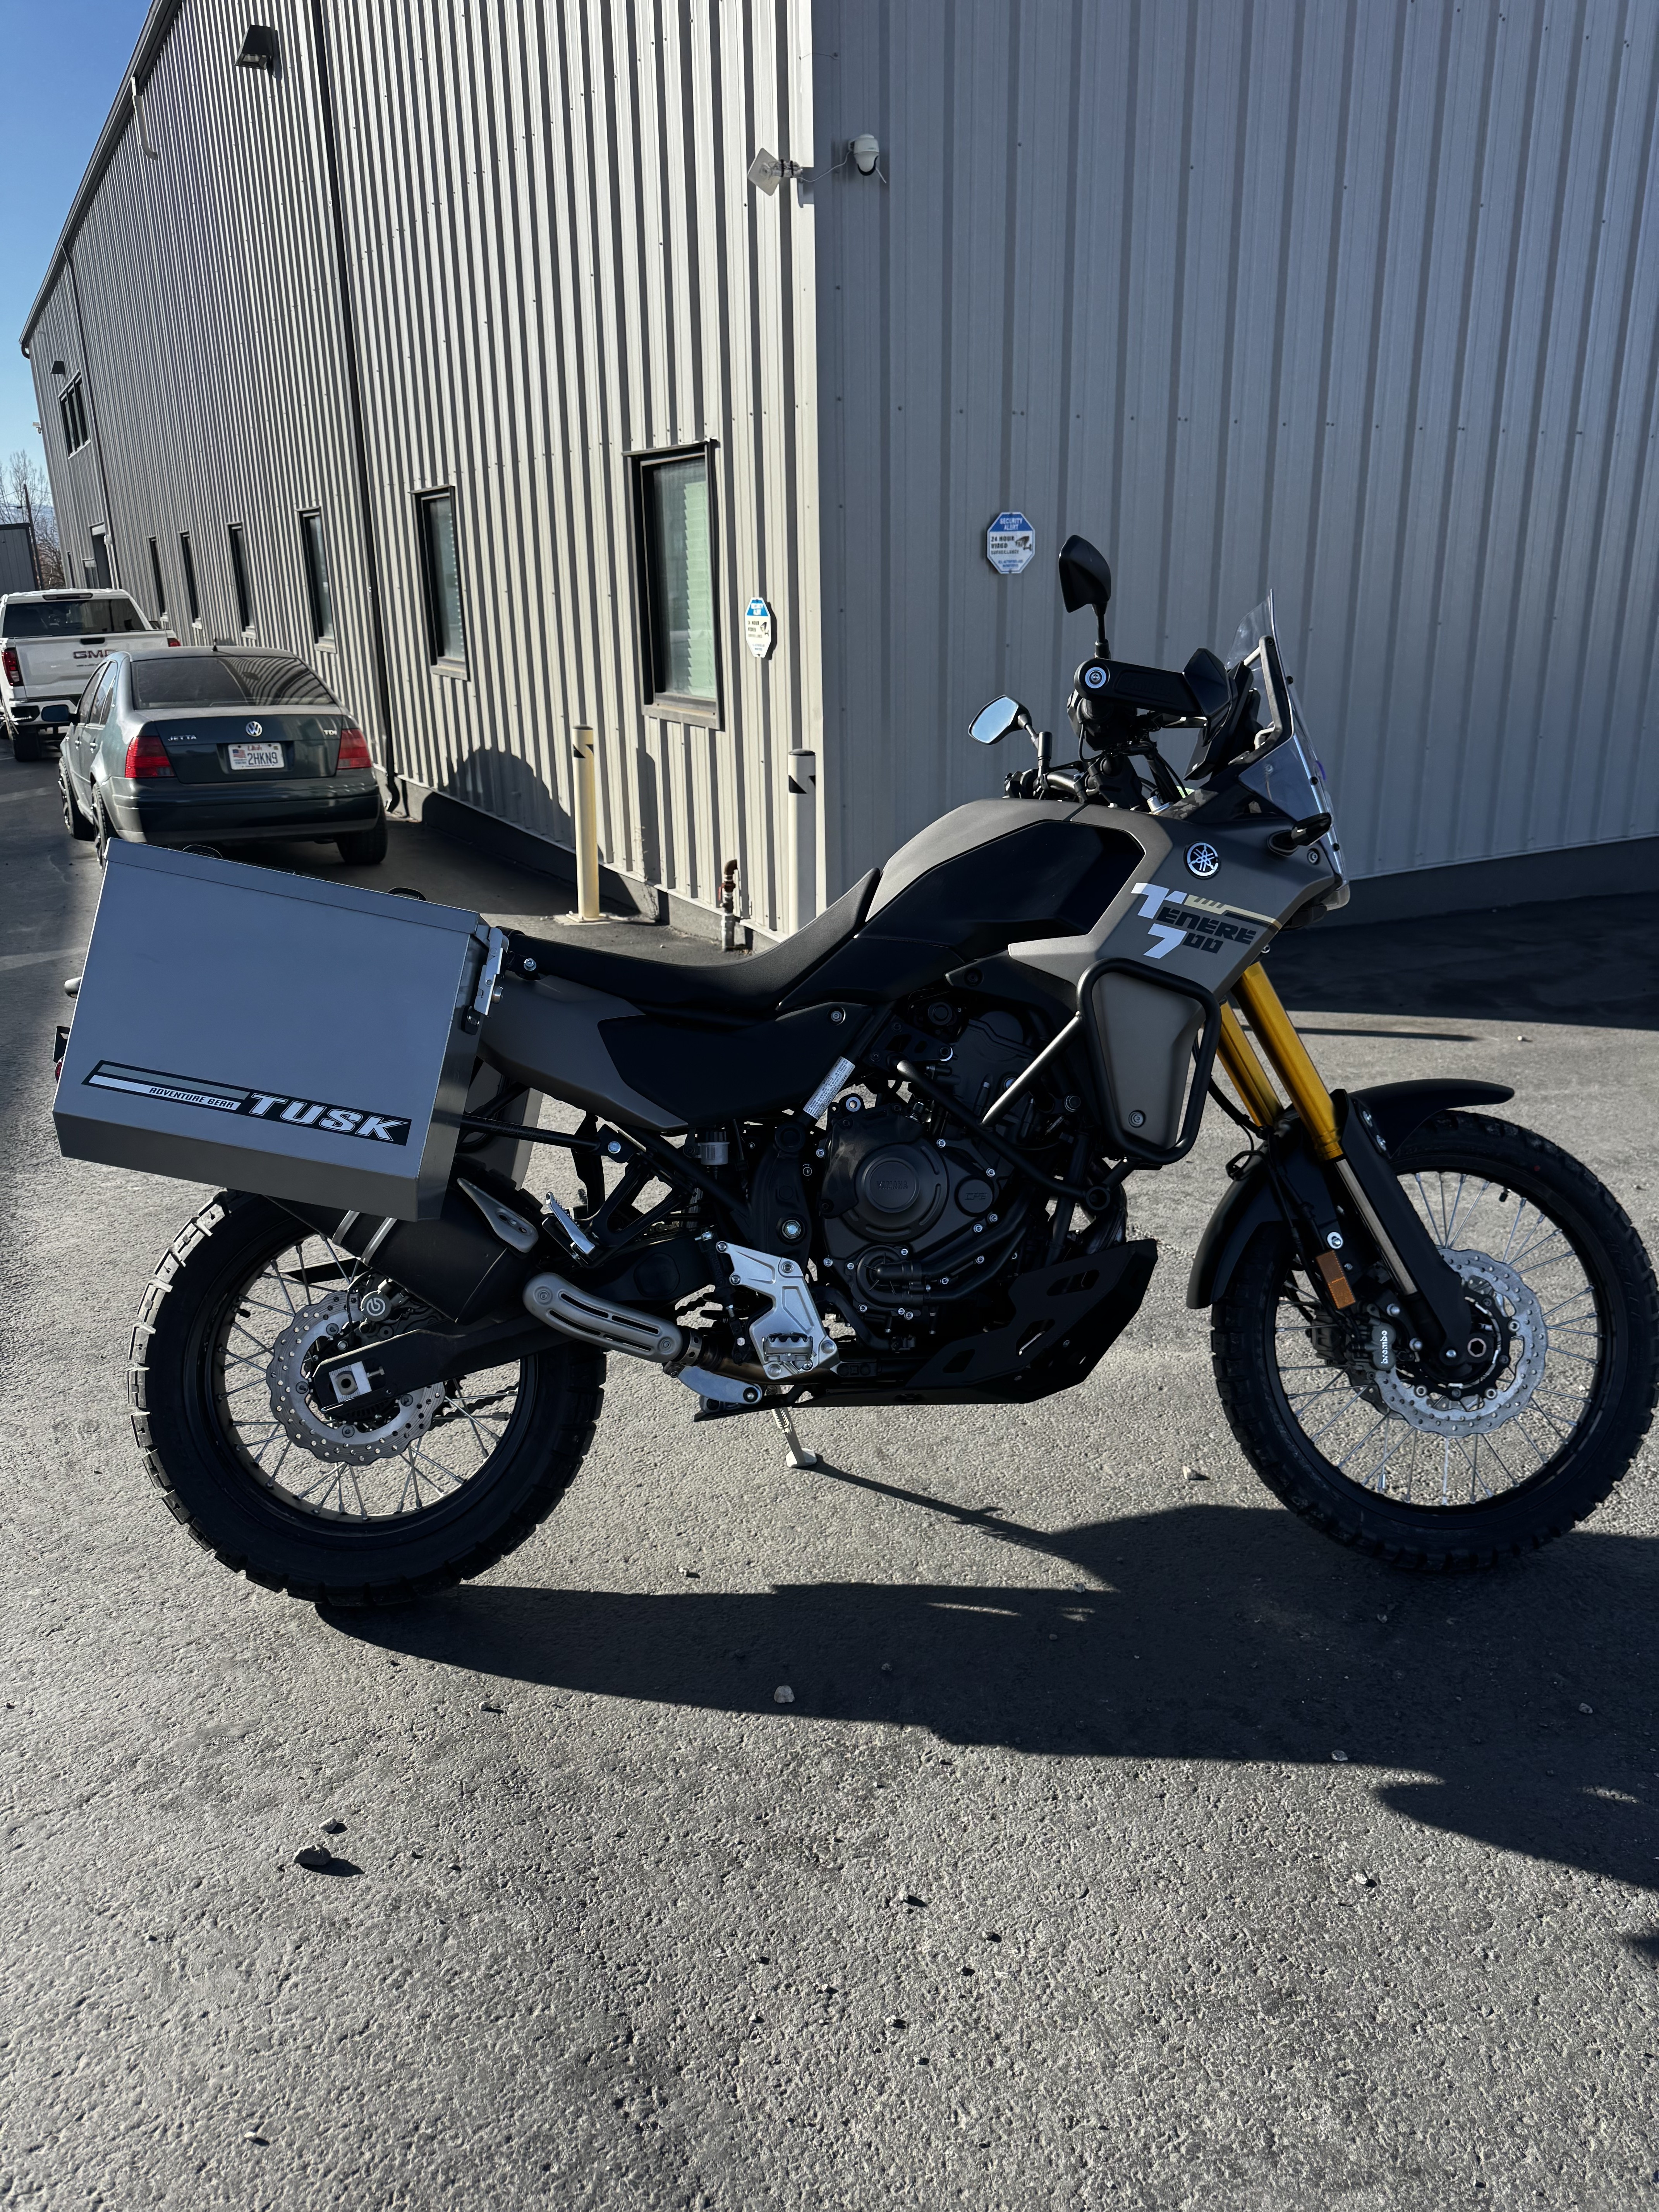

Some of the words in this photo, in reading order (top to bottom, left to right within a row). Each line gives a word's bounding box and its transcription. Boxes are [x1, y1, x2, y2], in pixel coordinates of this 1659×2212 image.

[247, 752, 278, 765] 2HKN9
[1143, 923, 1224, 960] 700
[149, 1086, 204, 1105] ADVENTURE
[207, 1097, 234, 1109] GEAR
[248, 1092, 410, 1142] TUSK
[876, 1180, 908, 1190] YAMAHA
[1380, 1330, 1389, 1364] brembo
